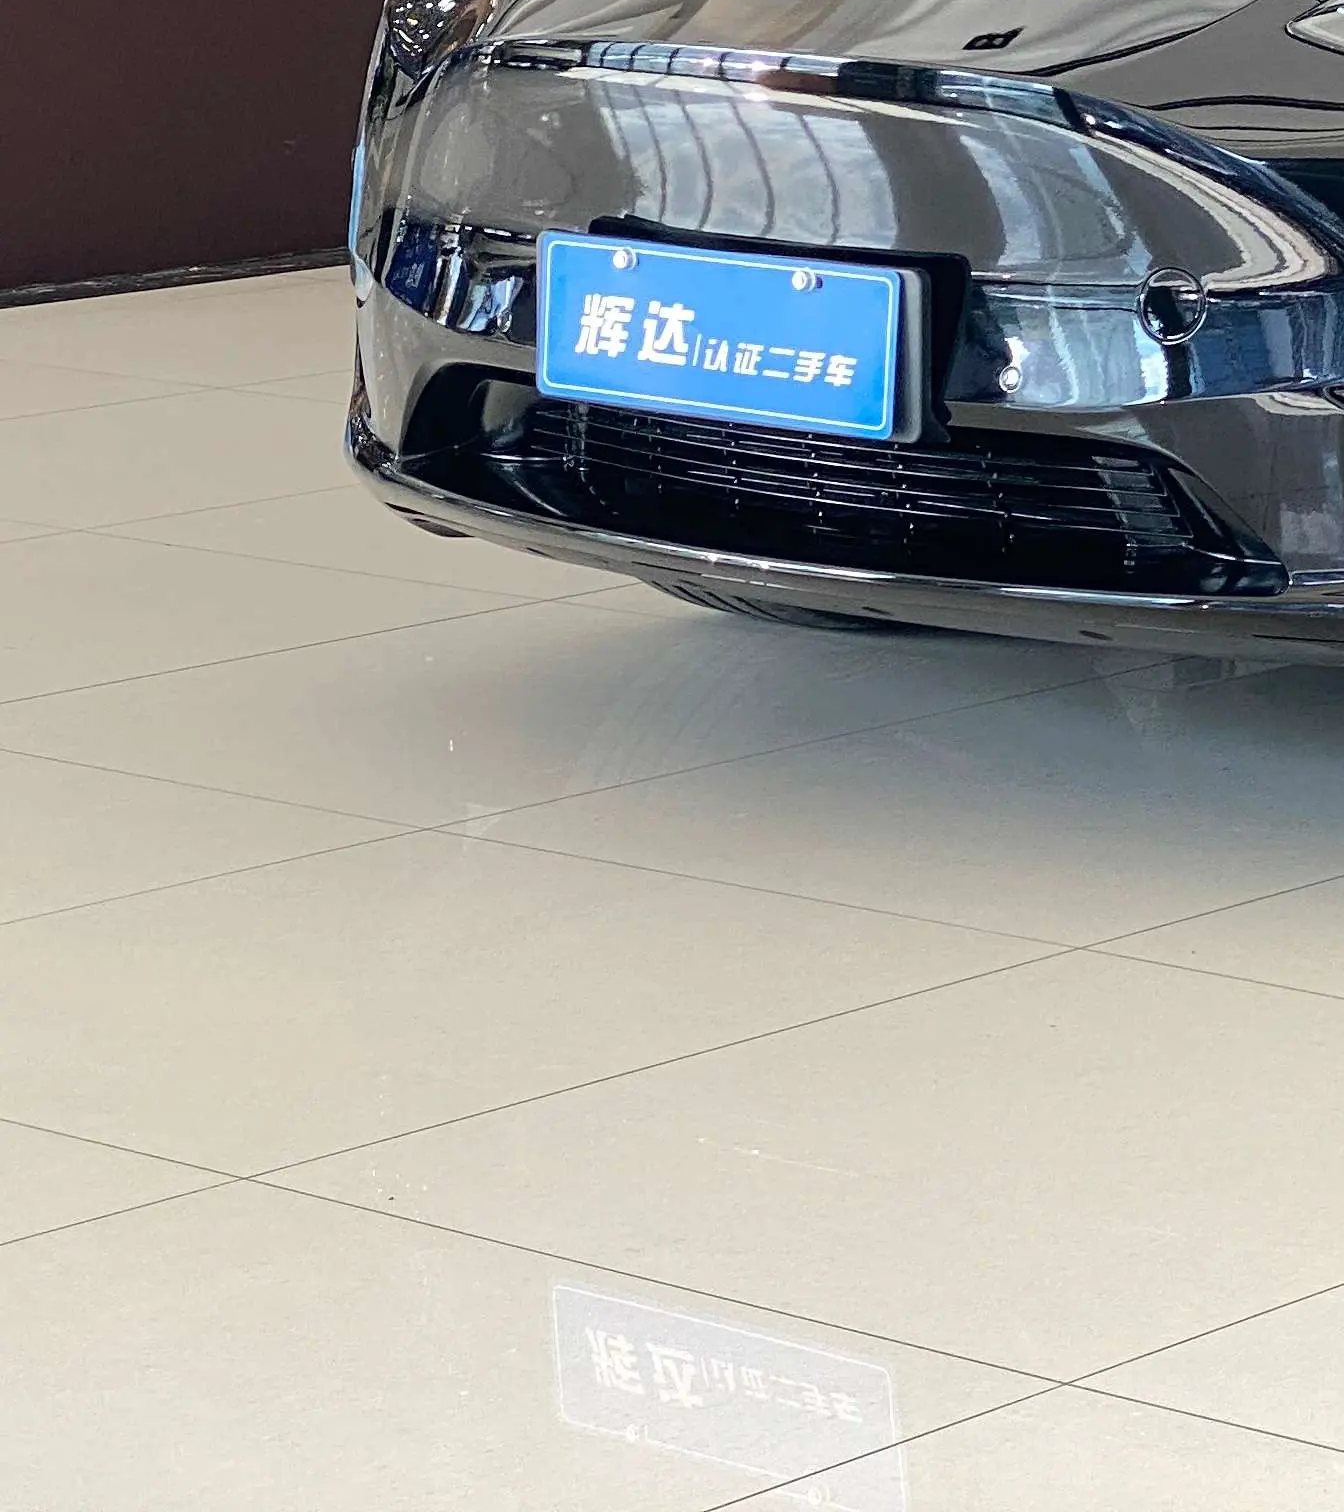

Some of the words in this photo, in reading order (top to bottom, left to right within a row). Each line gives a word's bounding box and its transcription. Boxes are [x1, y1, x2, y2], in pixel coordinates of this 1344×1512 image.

[574, 293, 695, 367] 辉达
[703, 339, 859, 388] 认证二手车
